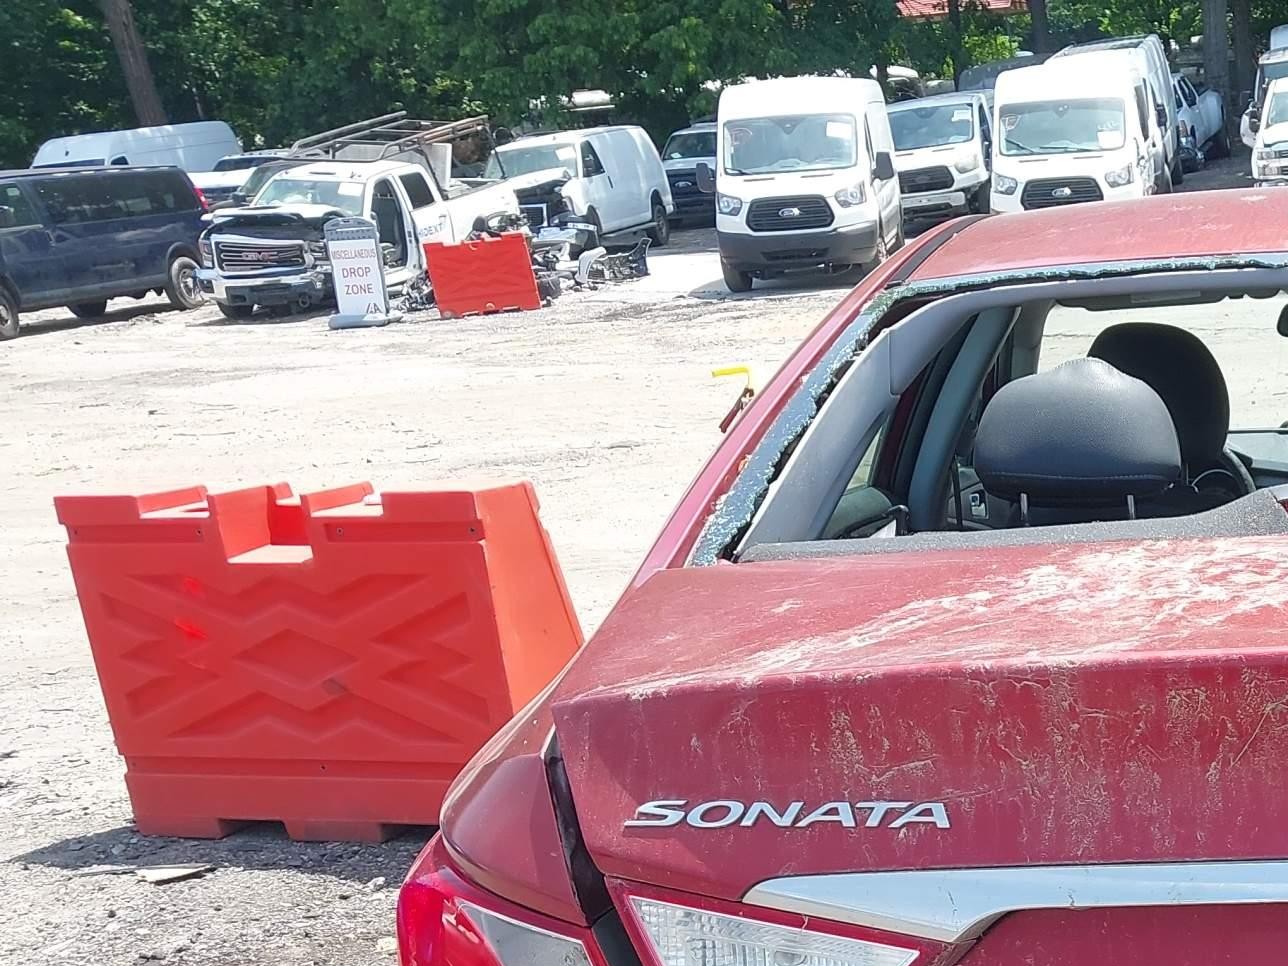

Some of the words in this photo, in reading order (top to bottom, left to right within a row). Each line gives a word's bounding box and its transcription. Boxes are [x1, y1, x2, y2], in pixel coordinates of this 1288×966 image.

[331, 247, 377, 260] MISCELLANEOUS
[341, 266, 371, 279] DROP
[345, 283, 374, 295] ZONE
[623, 800, 951, 829] SONATA
